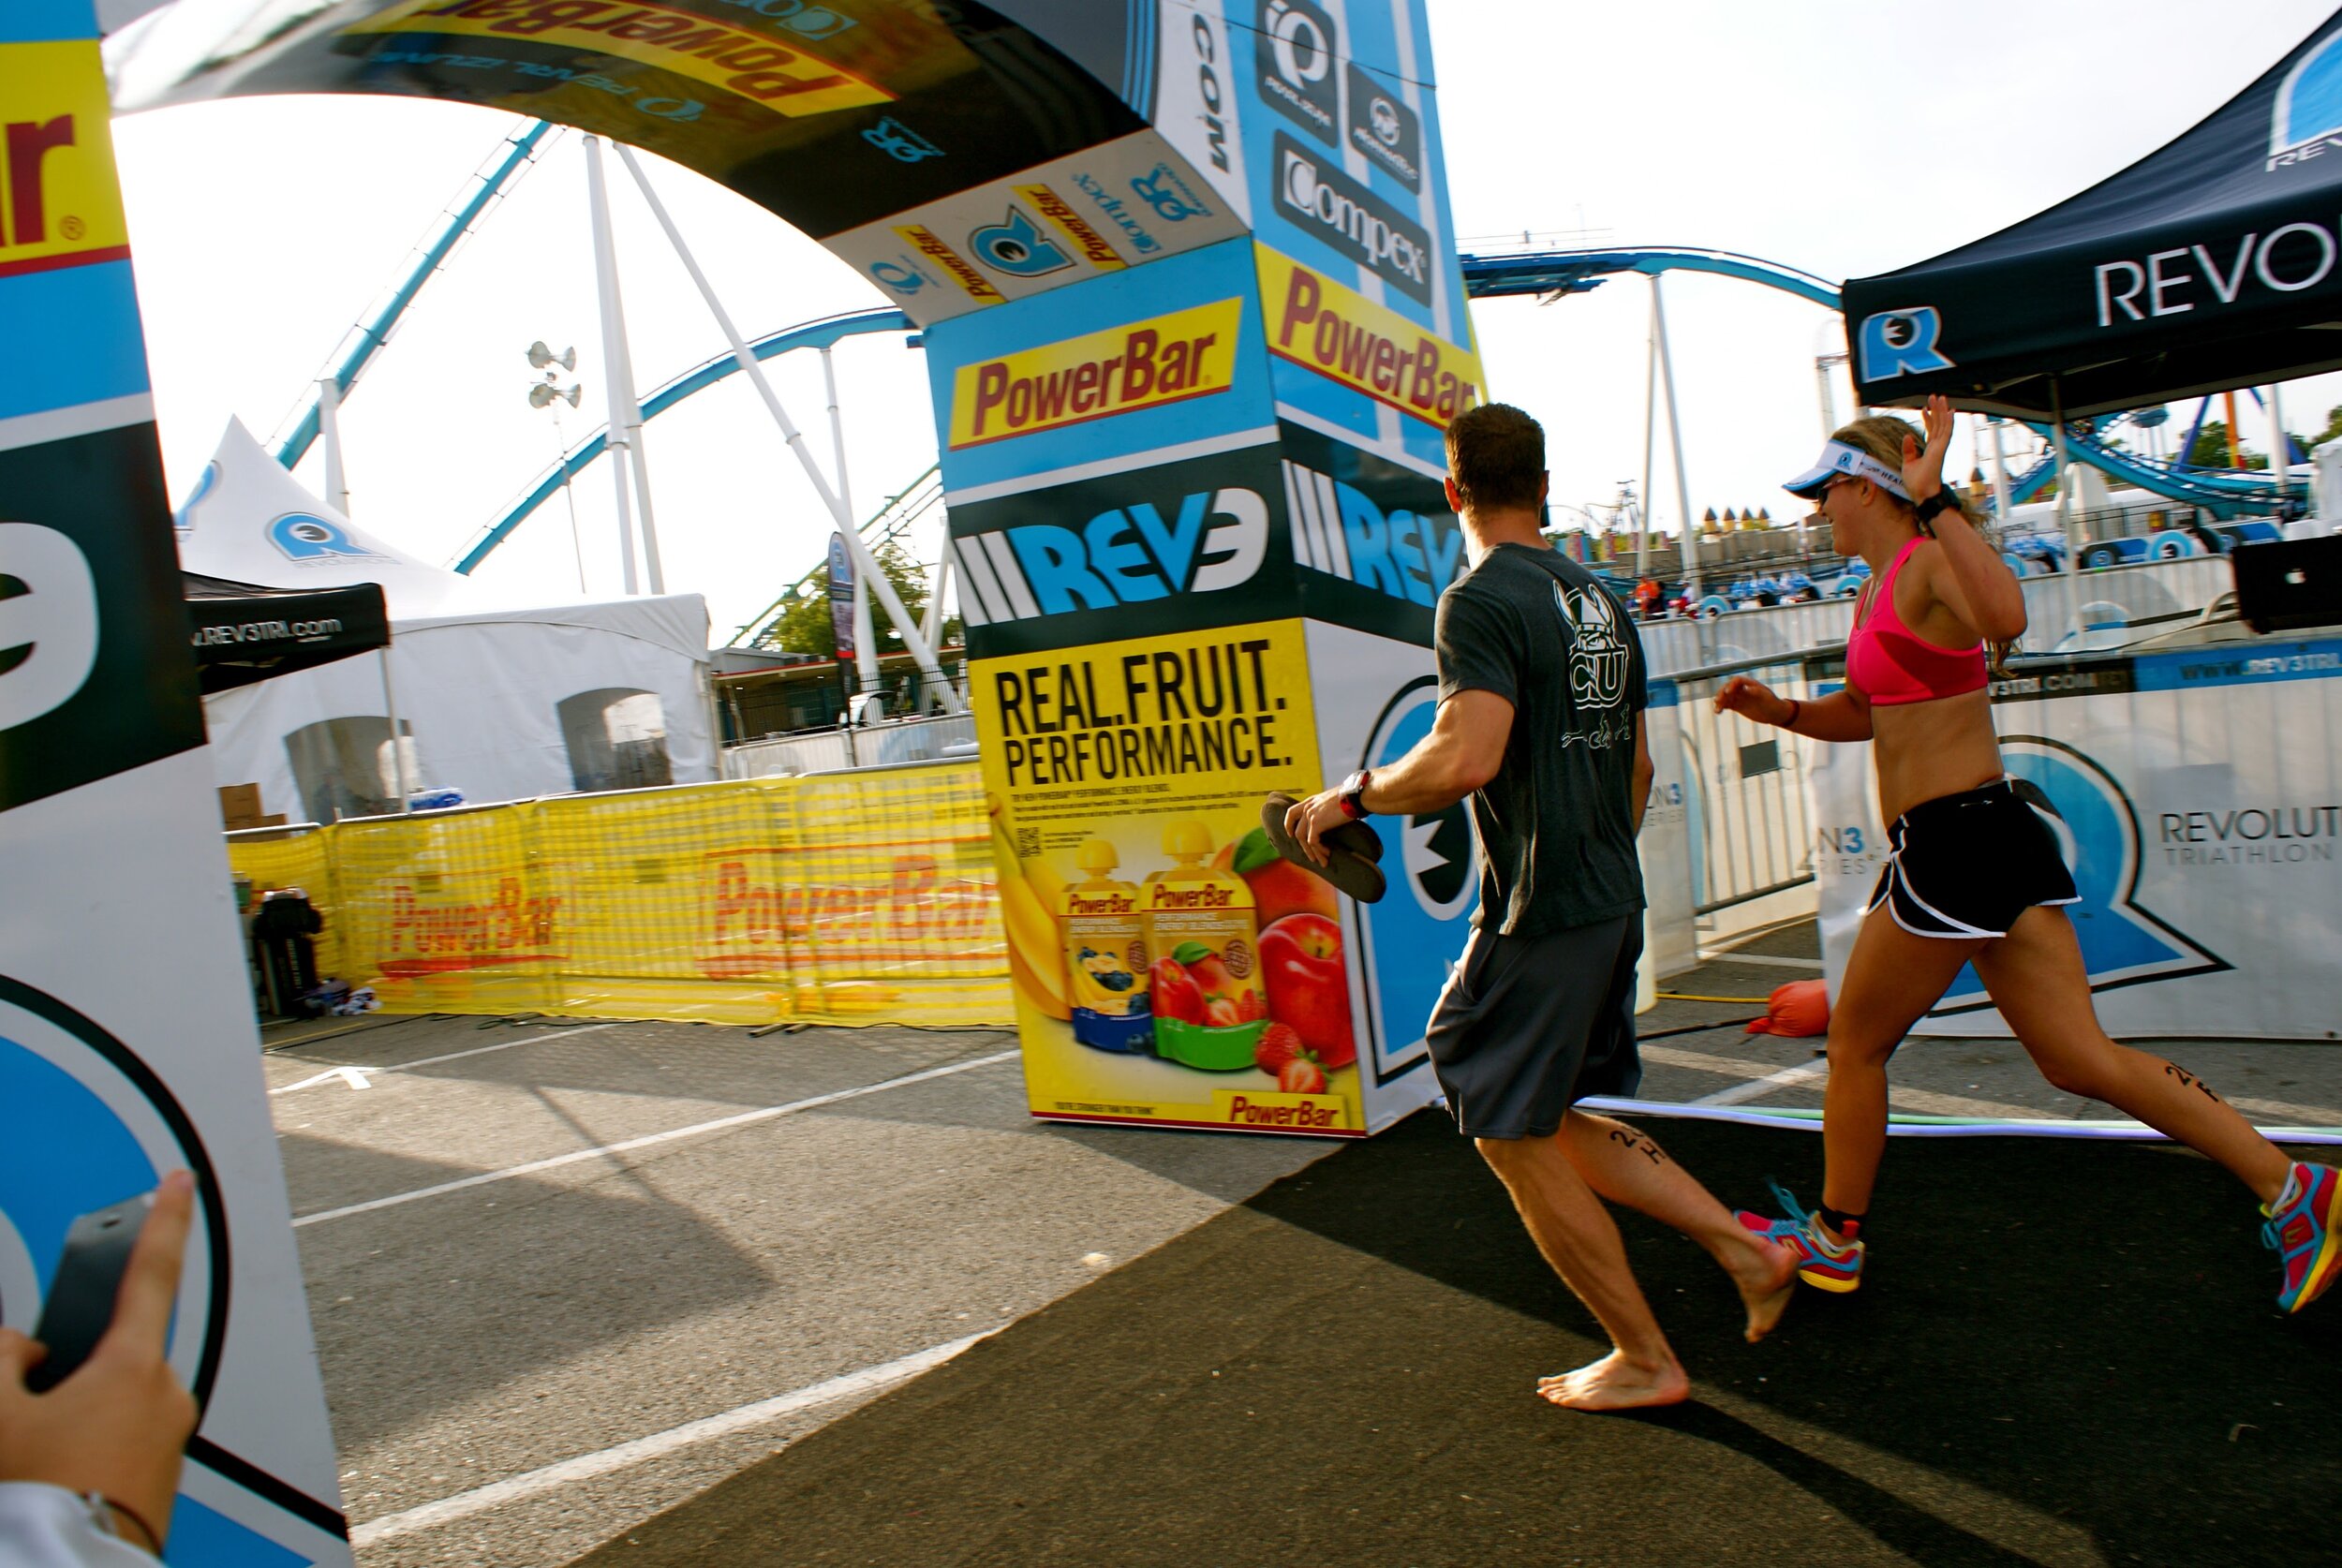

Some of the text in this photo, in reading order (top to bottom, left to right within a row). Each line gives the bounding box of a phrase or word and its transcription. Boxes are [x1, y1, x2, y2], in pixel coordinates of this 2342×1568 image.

[1027, 189, 1122, 263] PowerBar
[1283, 150, 1426, 285] Compex
[907, 229, 998, 298] PowerBar
[2095, 214, 2342, 327] REVO
[971, 329, 1217, 436] PowerBar
[1280, 267, 1476, 424] PowerBar
[1334, 481, 1469, 610] REV
[1003, 715, 1293, 787] PERFORMANCE.
[2159, 806, 2342, 843] REVOLUT
[2163, 842, 2335, 866] TRIATHLON
[391, 876, 562, 954] PowerBar
[715, 854, 1000, 946] PowerBar
[1068, 893, 1135, 914] PowerBar
[1151, 883, 1234, 909] PowerBar
[1229, 1095, 1339, 1129] PowerBar
